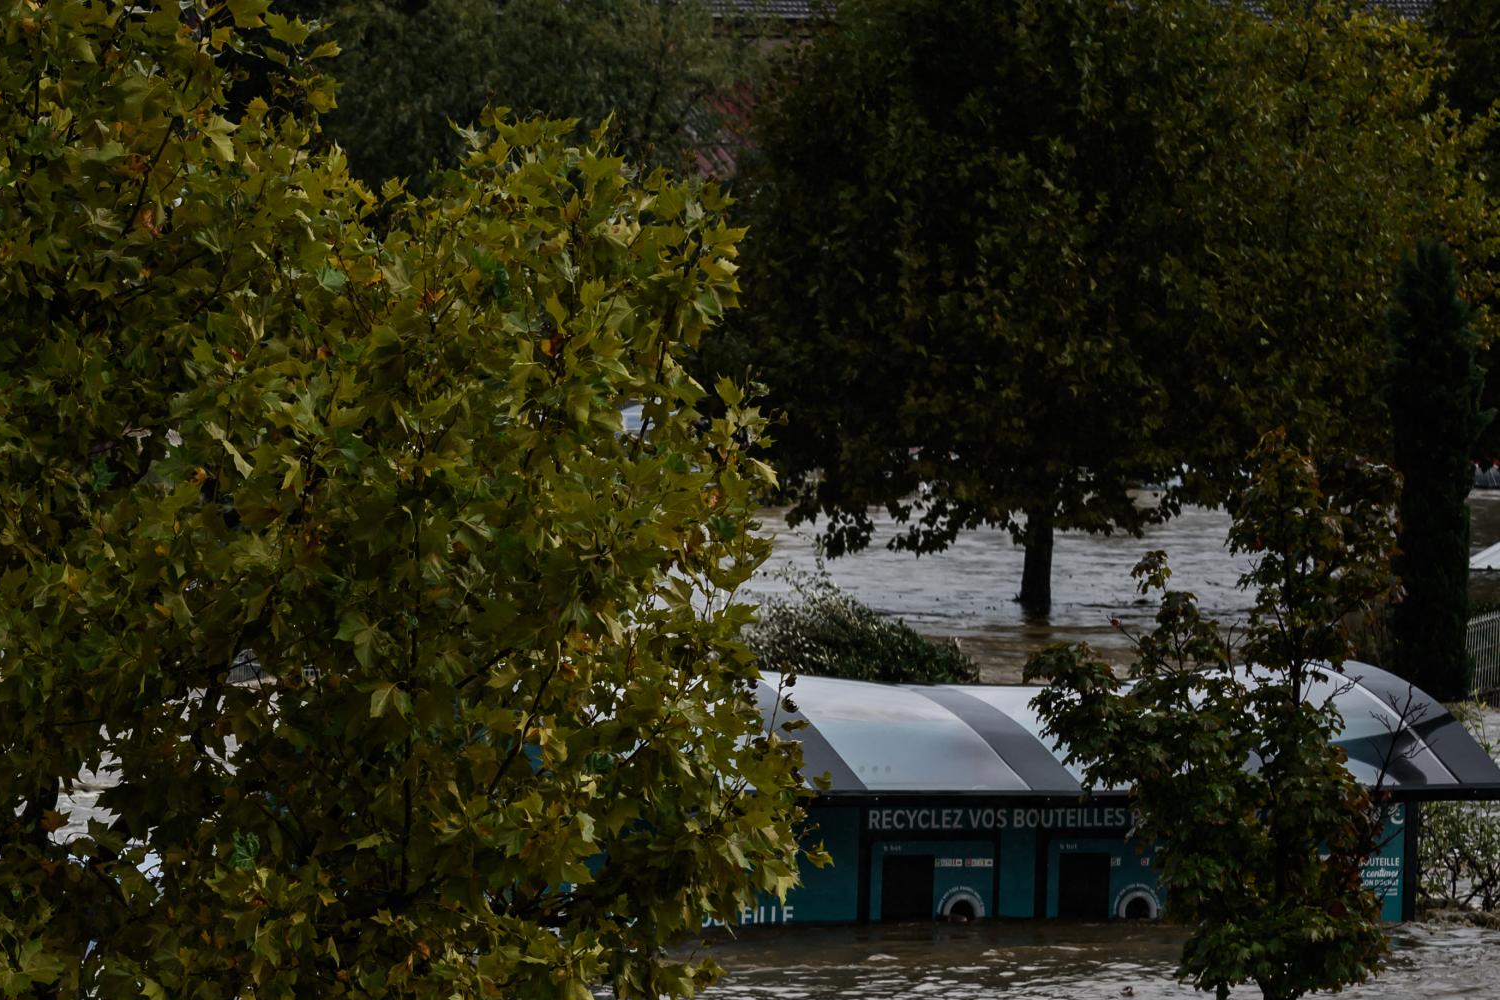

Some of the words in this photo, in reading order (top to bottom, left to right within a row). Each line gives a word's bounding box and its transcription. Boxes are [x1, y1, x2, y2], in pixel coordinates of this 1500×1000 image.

[868, 809, 963, 830] RECYCLEZ
[968, 808, 1008, 829] VOS
[1013, 807, 1126, 829] BOUTEILLES
